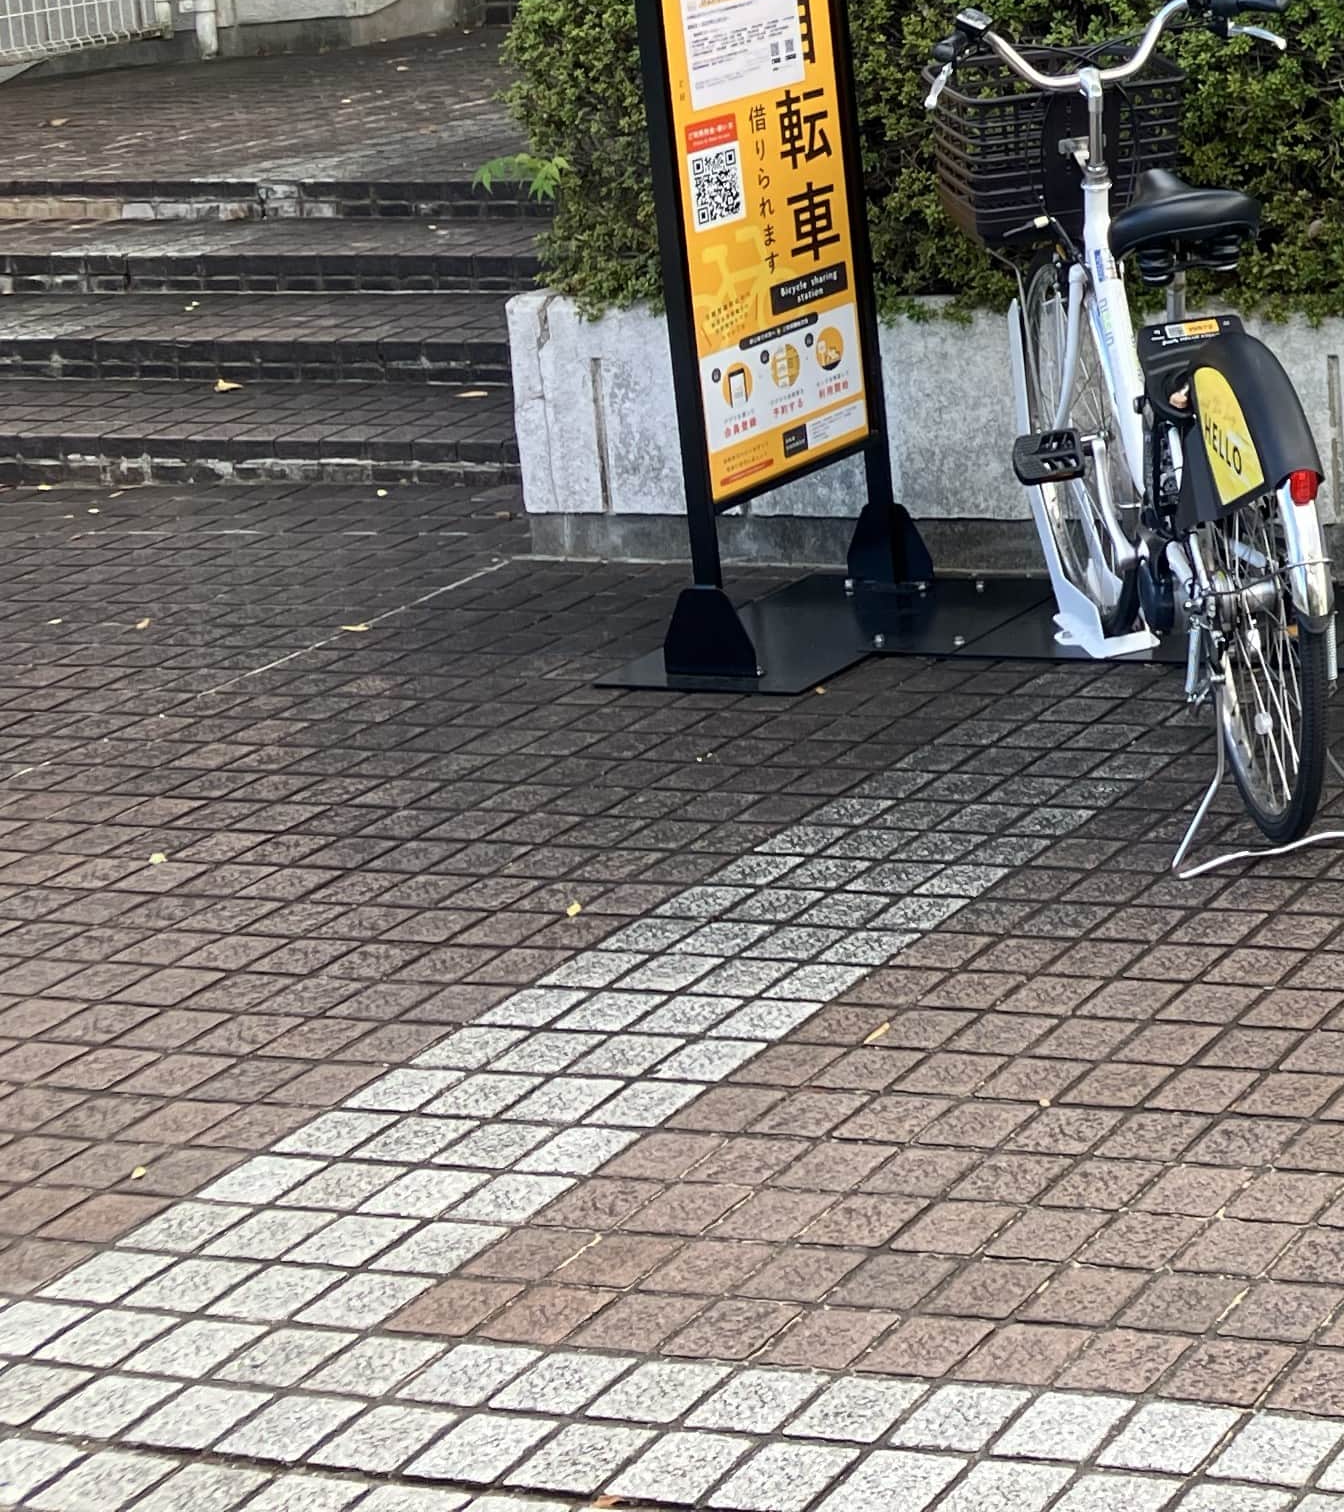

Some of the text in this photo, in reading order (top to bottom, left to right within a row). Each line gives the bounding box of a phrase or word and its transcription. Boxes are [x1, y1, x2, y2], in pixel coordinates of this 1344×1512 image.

[748, 104, 779, 275] 借りられます
[780, 271, 838, 298] Bicycle sharing
[797, 288, 824, 304] station
[1204, 412, 1242, 475] HELLO
